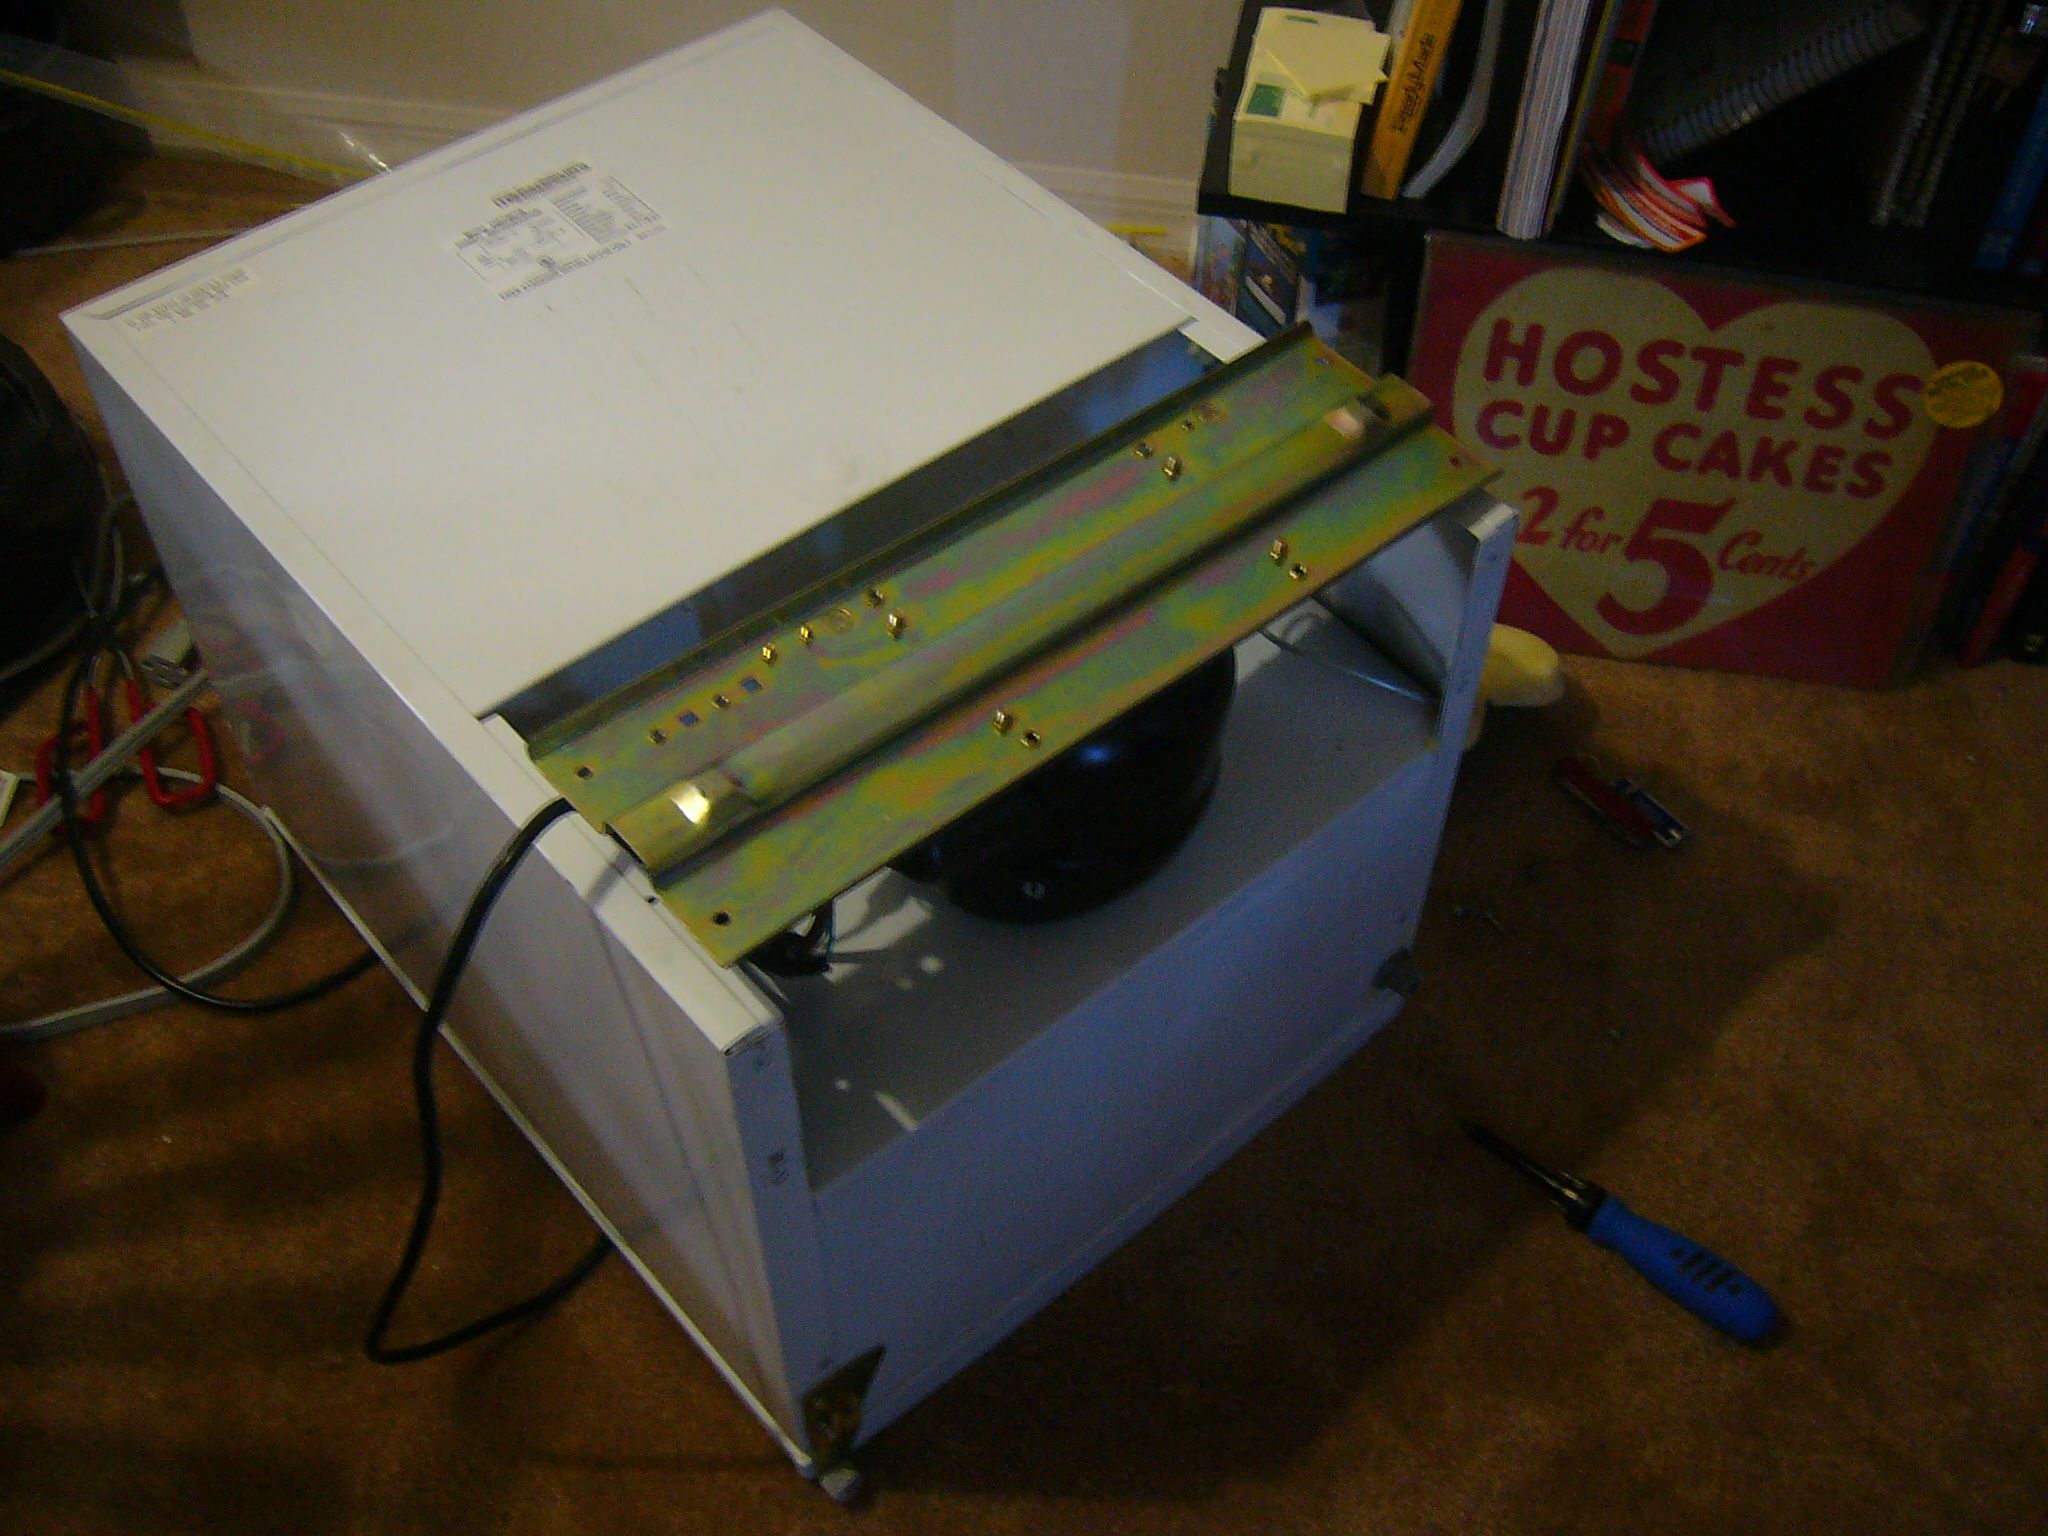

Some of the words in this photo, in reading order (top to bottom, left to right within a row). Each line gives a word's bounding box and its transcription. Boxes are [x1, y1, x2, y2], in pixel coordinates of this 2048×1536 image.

[1483, 318, 1926, 439] HOSTESS
[1475, 399, 1630, 461] CUP
[1652, 422, 1892, 499] CAKES
[1516, 486, 1558, 546] 2
[1558, 506, 1624, 554] for
[1596, 497, 1736, 636] 5
[1717, 529, 1817, 581] Cents
